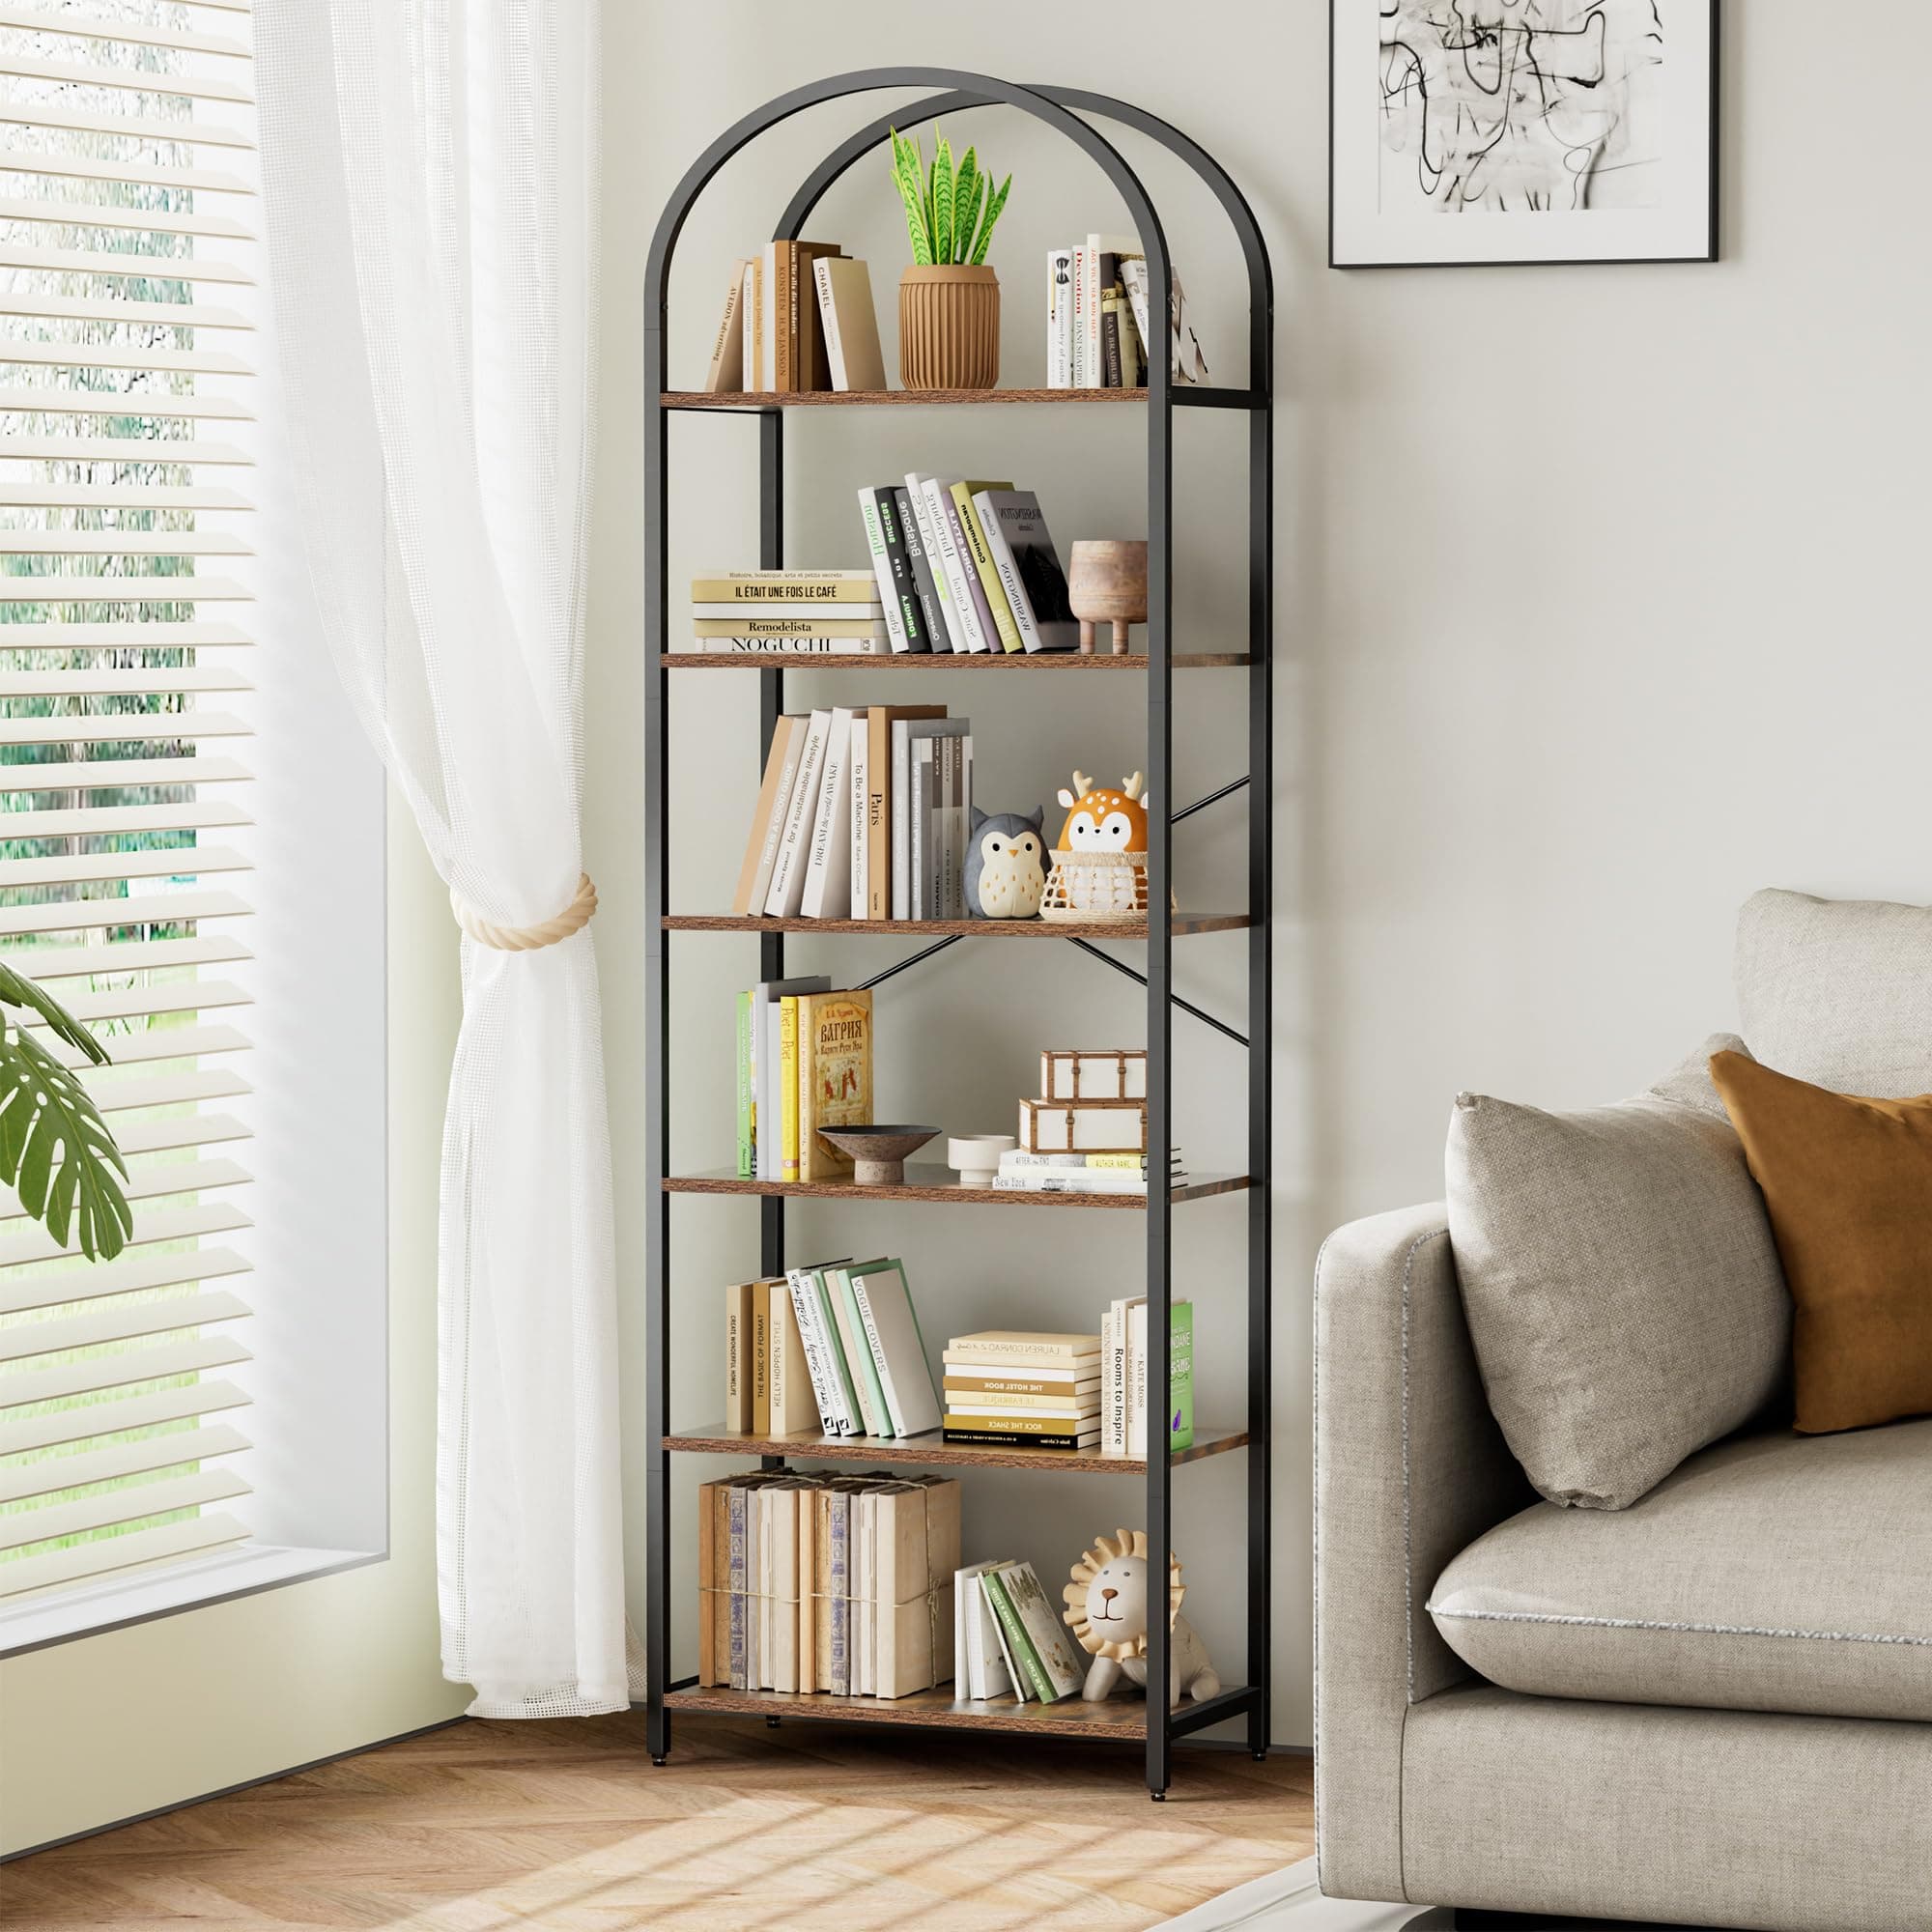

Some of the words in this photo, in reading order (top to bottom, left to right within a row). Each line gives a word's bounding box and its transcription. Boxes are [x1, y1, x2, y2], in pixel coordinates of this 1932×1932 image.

[818, 267, 831, 309] CHANEL
[724, 286, 738, 320] AVEDON
[1106, 316, 1116, 334] RAY
[713, 322, 728, 362] advertising
[1059, 348, 1066, 357] of
[1107, 336, 1119, 387] BRADBURY
[735, 586, 743, 598] IL
[745, 583, 766, 598] ÉTAIT
[768, 586, 783, 598] UNE
[786, 586, 803, 598] FOIS
[805, 586, 814, 598] LE
[816, 583, 837, 598] CAFÉ
[749, 621, 812, 633] Remodelista
[731, 638, 831, 652] NOGUCHI
[781, 762, 793, 793] GUIDE
[825, 760, 838, 796] AWAKE
[855, 764, 864, 775] To
[787, 830, 797, 843] for
[794, 771, 812, 821] sustainable
[806, 735, 820, 770] lifestyle
[855, 777, 864, 790] Be
[773, 794, 786, 823] GOOD
[822, 797, 833, 817] world
[870, 793, 883, 826] Paris
[772, 824, 779, 833] A
[820, 817, 829, 828] the
[855, 801, 864, 841] Machine
[762, 844, 775, 866] THIS
[814, 828, 828, 867] DREAM
[781, 1008, 795, 1027] Poet
[820, 1020, 862, 1043] ВАГРИЯ
[781, 1041, 795, 1060] Poet
[773, 1321, 781, 1345] STYLE
[854, 1279, 869, 1321] VOGUE
[866, 1323, 887, 1374] COVERS
[757, 1348, 764, 1358] OF
[773, 1347, 781, 1379] HOPPEN
[1115, 1348, 1123, 1387] Rooms
[773, 1382, 781, 1407] KELLY
[1115, 1390, 1123, 1403] to
[1112, 1406, 1124, 1445] Inspire
